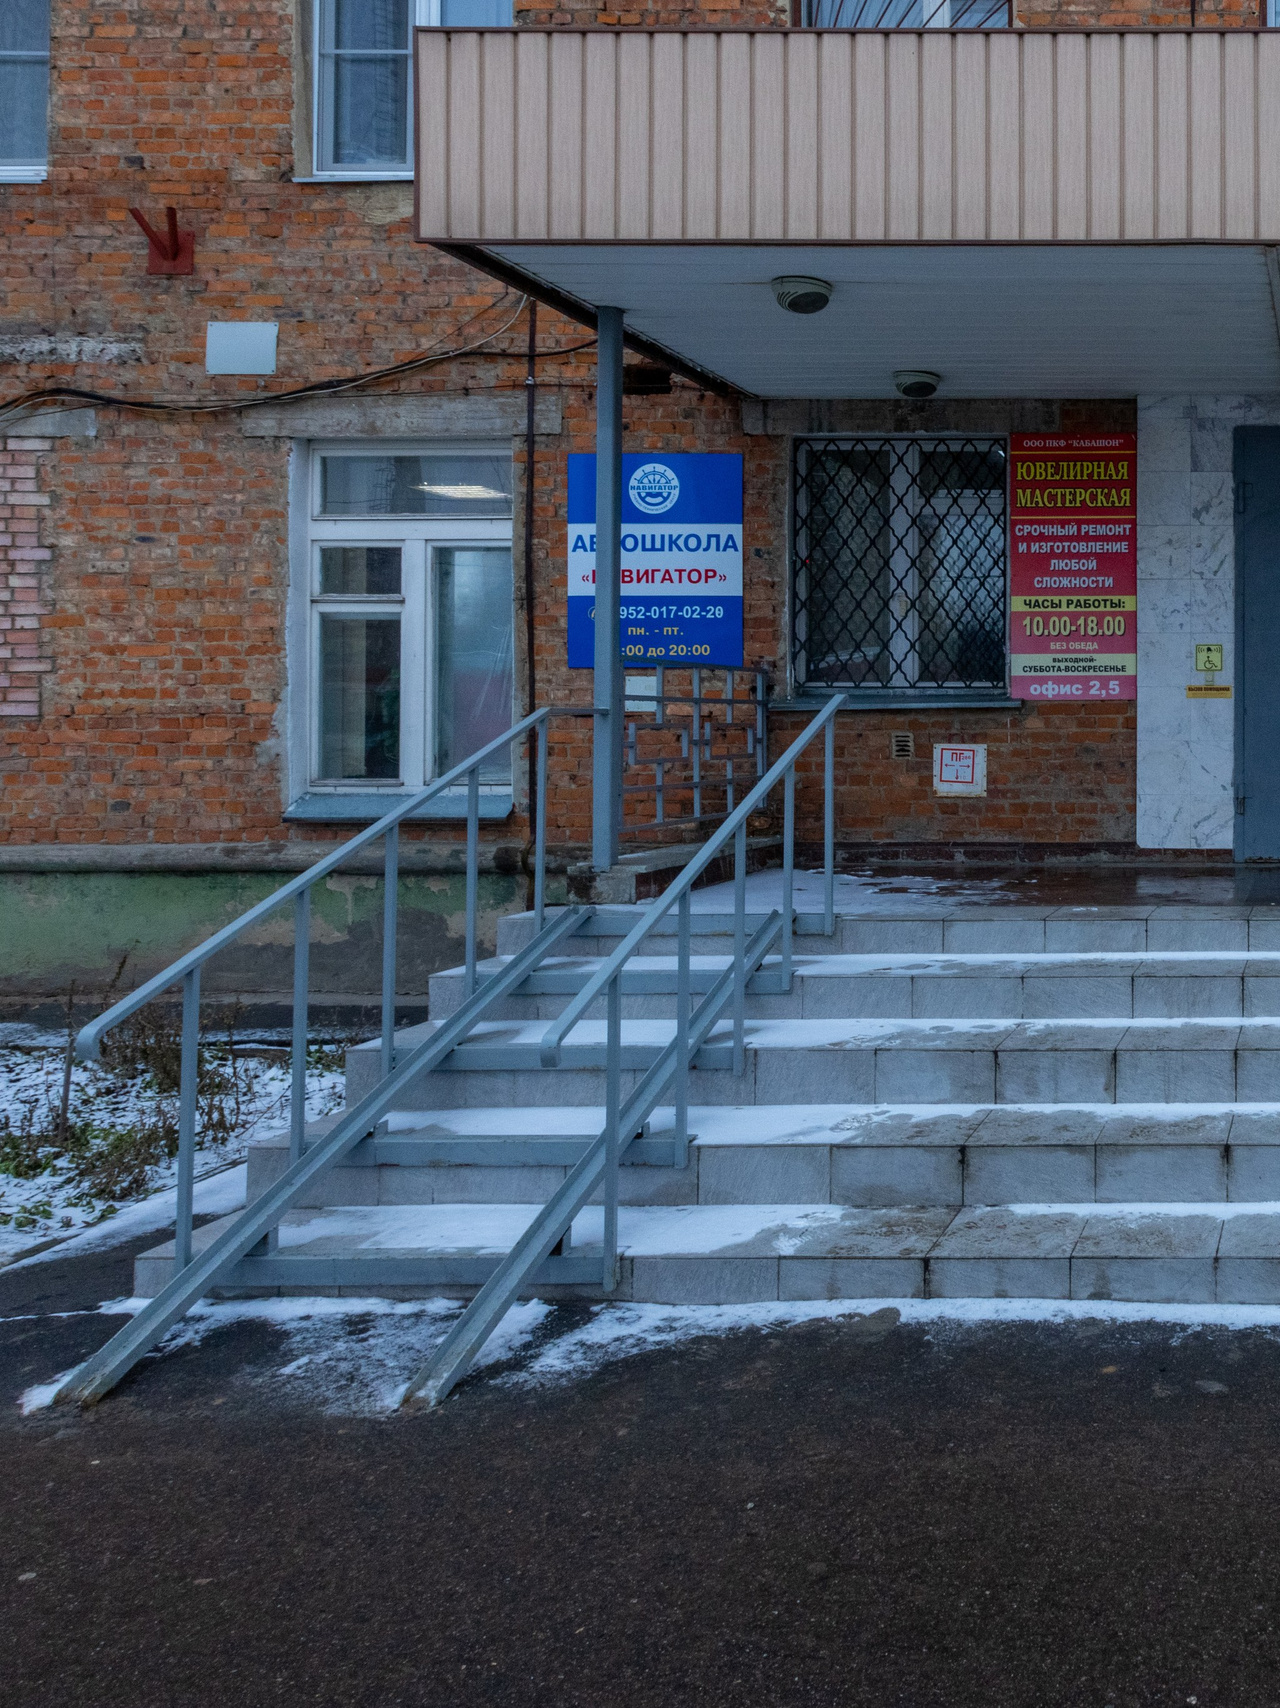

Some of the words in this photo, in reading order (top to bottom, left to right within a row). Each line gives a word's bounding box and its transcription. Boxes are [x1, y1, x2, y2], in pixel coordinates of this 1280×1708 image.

[1016, 461, 1129, 480] ЮВЕЛИРНАЯ
[1016, 488, 1131, 507] МАСТЕРСКАЯ
[1015, 522, 1078, 536] СРОЧНЫЙ
[1081, 524, 1132, 536] РЕМОНТ
[571, 533, 739, 552] АОШКОЛА
[1018, 542, 1027, 554] И
[1030, 541, 1129, 554] ИЗГОТОВЛЕНИЕ
[1050, 556, 1097, 570] ЛЮБОЙ
[581, 568, 727, 584] «ВИГАТОР»
[1034, 576, 1114, 588] СЛОЖНОСТИ
[1023, 599, 1062, 609] ЧАСЫ
[1066, 598, 1126, 609] РАБОТЫ:
[1022, 616, 1126, 636] 10.00-18.00
[647, 647, 665, 657] до
[669, 644, 710, 656] 20:00
[1050, 642, 1067, 650] БЕЗ
[1069, 642, 1098, 651] ОБЕДА
[1022, 665, 1126, 673] СУББОТА-ВОСКРЕСЕНЬЕ
[1029, 681, 1083, 698] офис
[1089, 680, 1120, 697] 2,5
